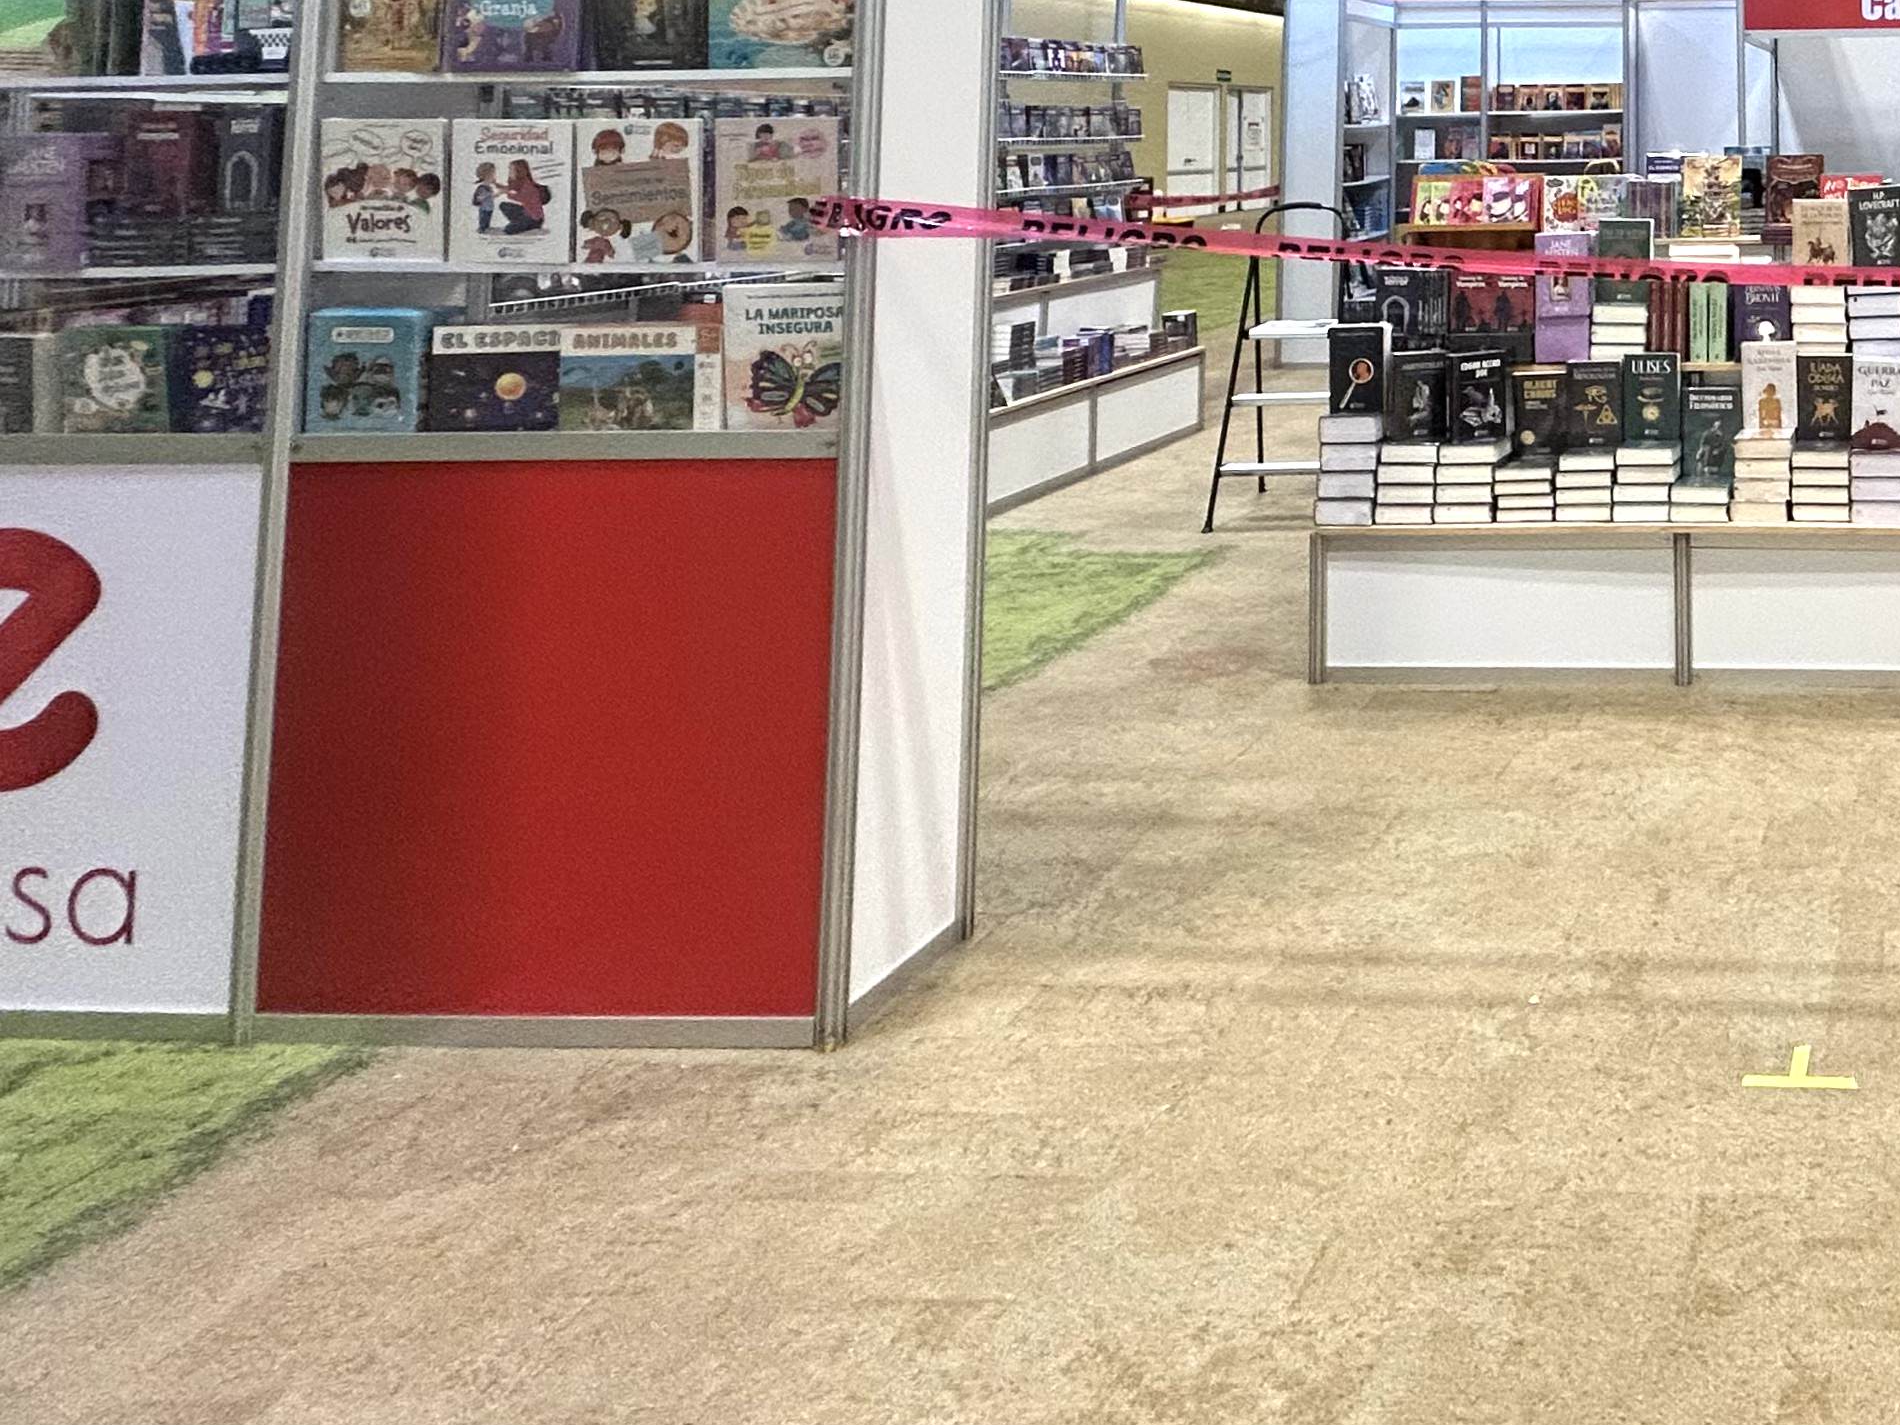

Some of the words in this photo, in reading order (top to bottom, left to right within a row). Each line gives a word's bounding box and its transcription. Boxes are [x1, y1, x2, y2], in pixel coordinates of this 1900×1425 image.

[479, 0, 537, 16] Granja
[479, 128, 549, 142] Seguridad
[474, 140, 553, 155] Emocional
[1859, 199, 1900, 210] LOVECRAFT
[346, 213, 411, 234] Valores
[745, 309, 762, 321] LA
[768, 306, 843, 320] MARIPOSA
[758, 322, 833, 335] INSEGURA
[572, 332, 678, 350] ANIMALES
[1632, 359, 1671, 374] ULISES
